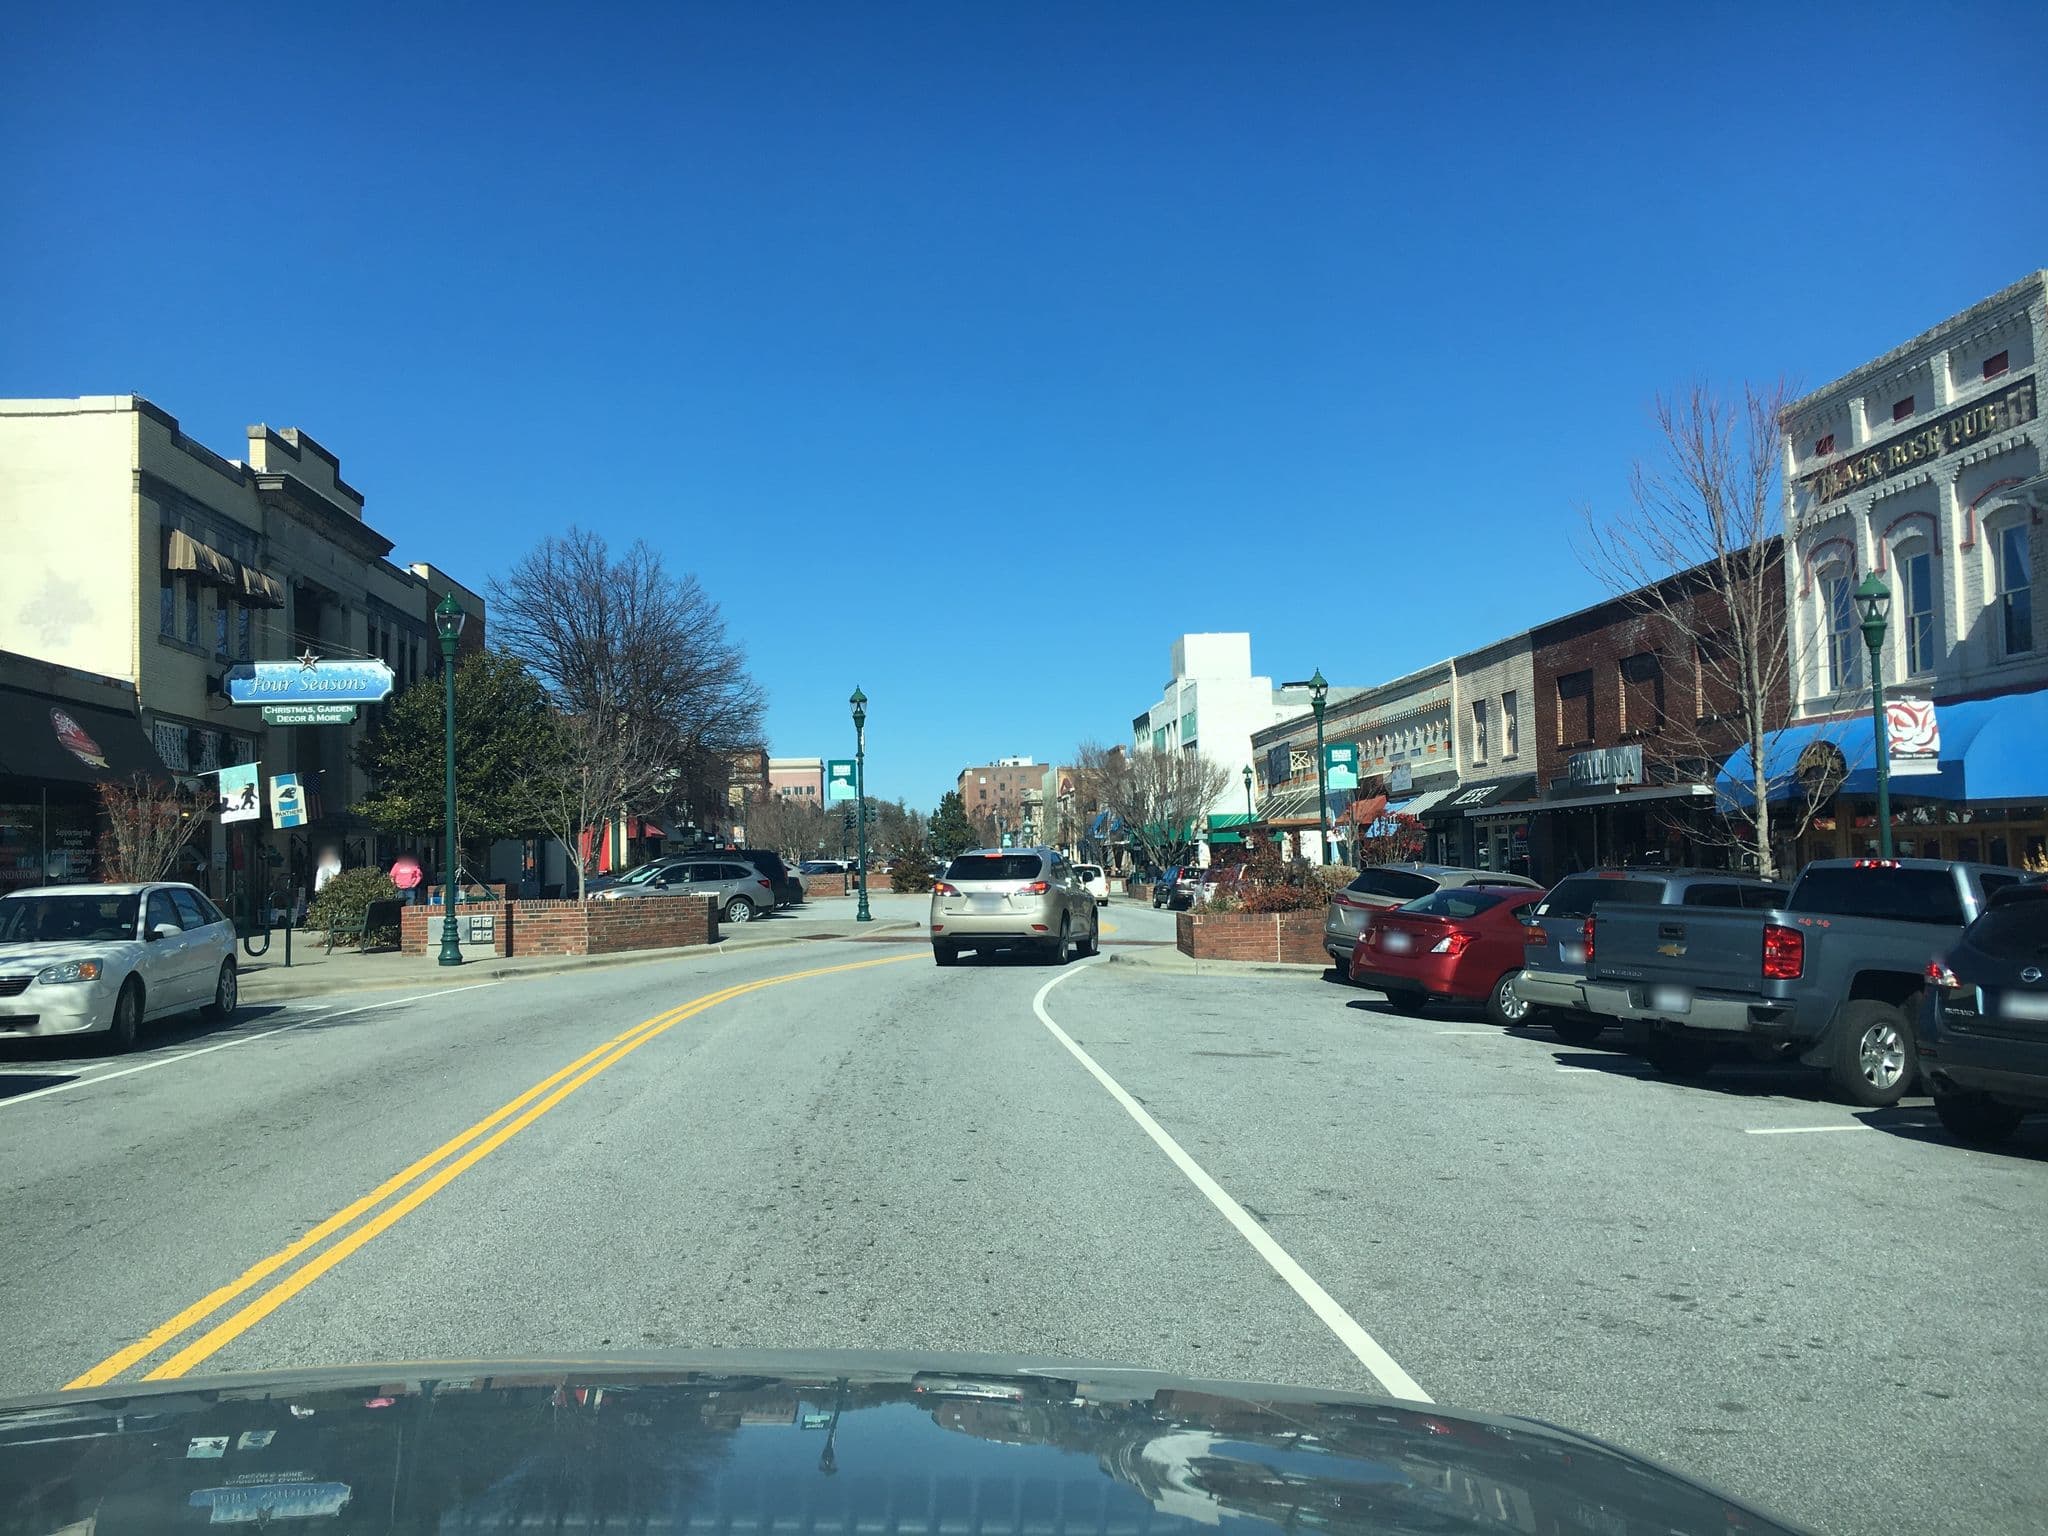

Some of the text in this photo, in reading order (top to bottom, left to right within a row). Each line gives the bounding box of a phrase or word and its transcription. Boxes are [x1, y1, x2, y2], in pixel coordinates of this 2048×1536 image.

[1820, 452, 1883, 500] BLACK
[1888, 425, 1942, 470] ROSE
[1951, 404, 1996, 445] PUB
[249, 675, 368, 696] Four Seasons
[264, 705, 353, 714] CHRISTMAS, GARDEN
[275, 808, 303, 817] PANTHERS
